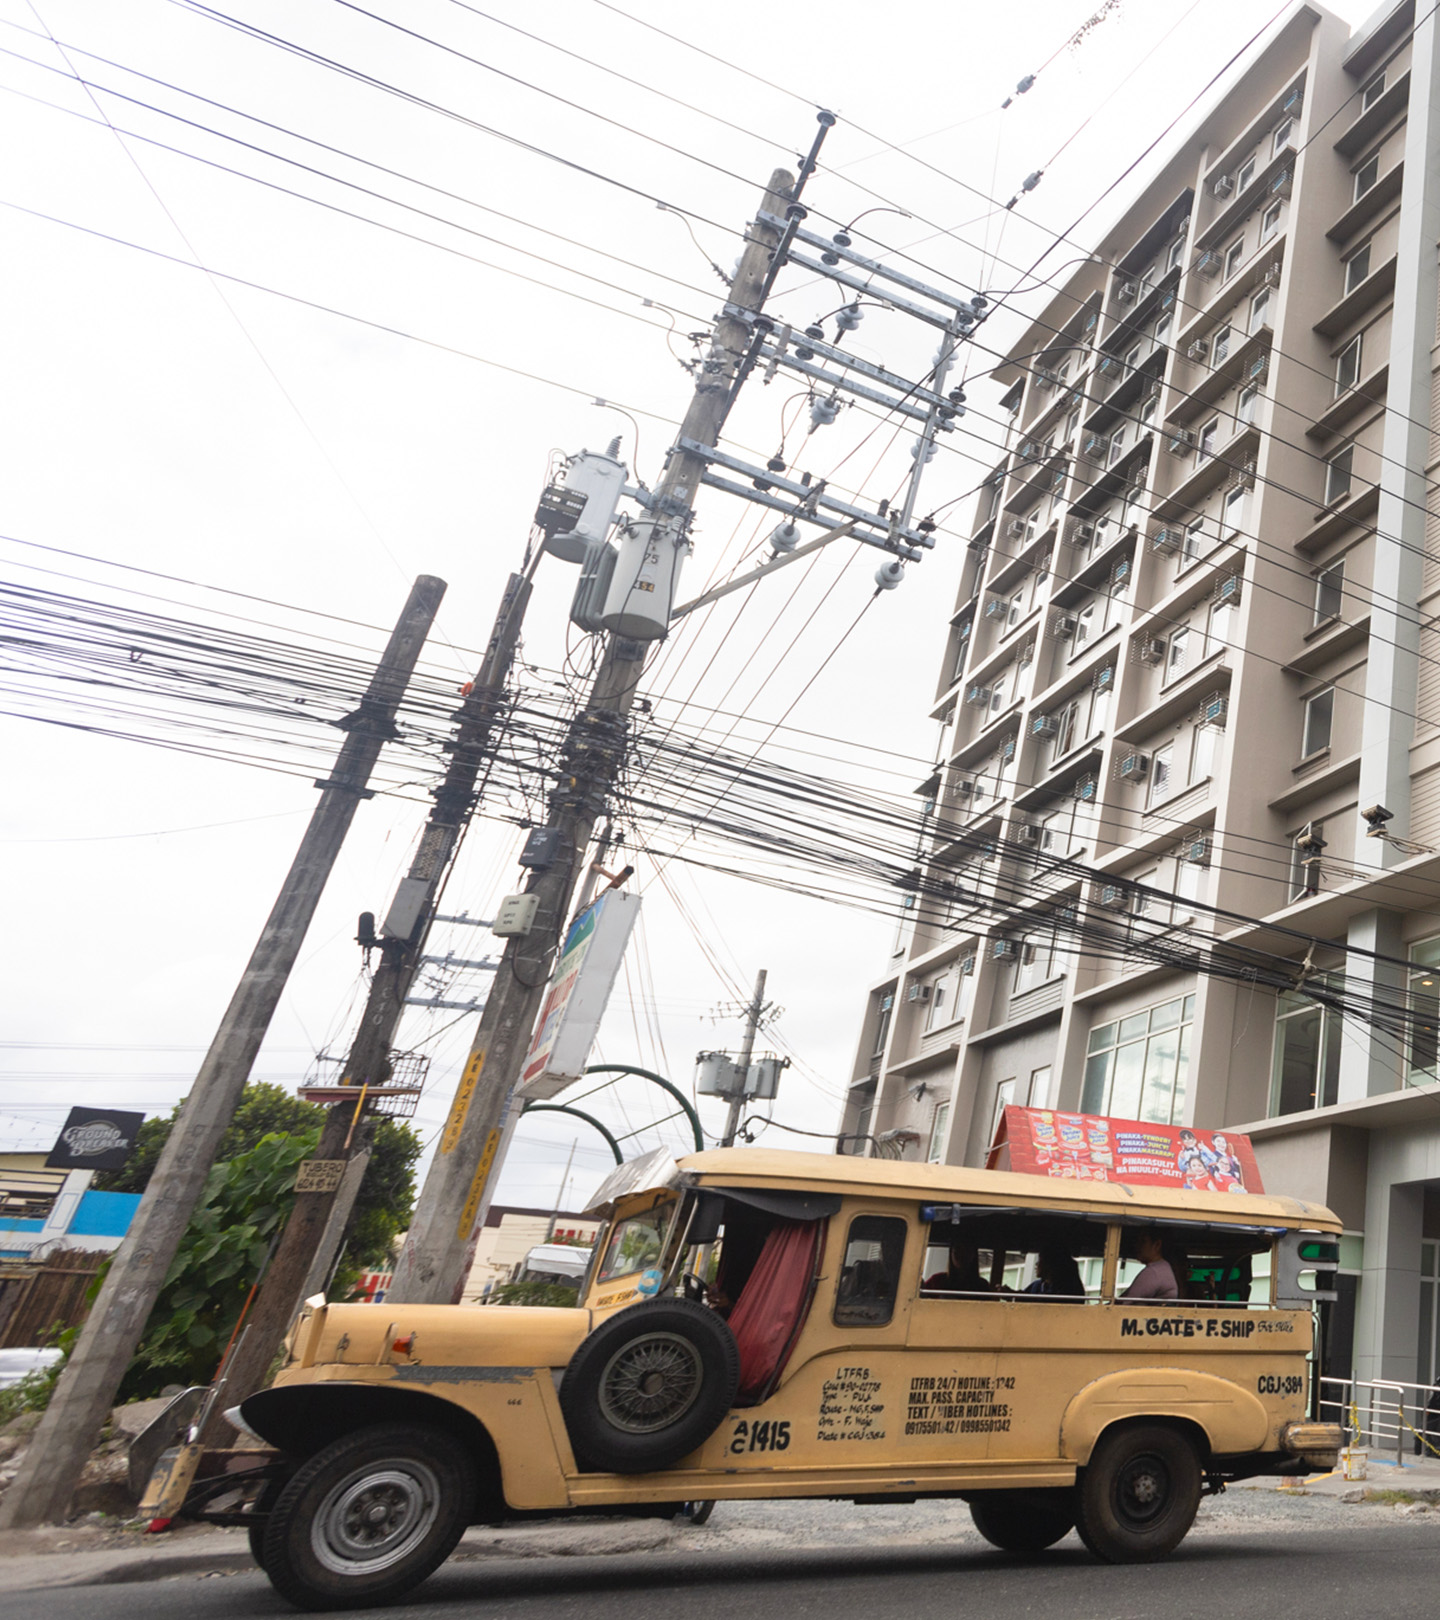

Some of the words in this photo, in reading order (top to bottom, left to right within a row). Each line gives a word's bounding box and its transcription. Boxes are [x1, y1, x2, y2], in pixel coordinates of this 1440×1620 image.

[1206, 1319, 1255, 1338] F.SHIP
[911, 1378, 936, 1390] LTFRB
[937, 1377, 957, 1390] 24/7
[908, 1392, 930, 1404] MAX.
[930, 1391, 954, 1404] PASS.
[908, 1406, 930, 1419] TEXT
[749, 1420, 791, 1452] 1415
